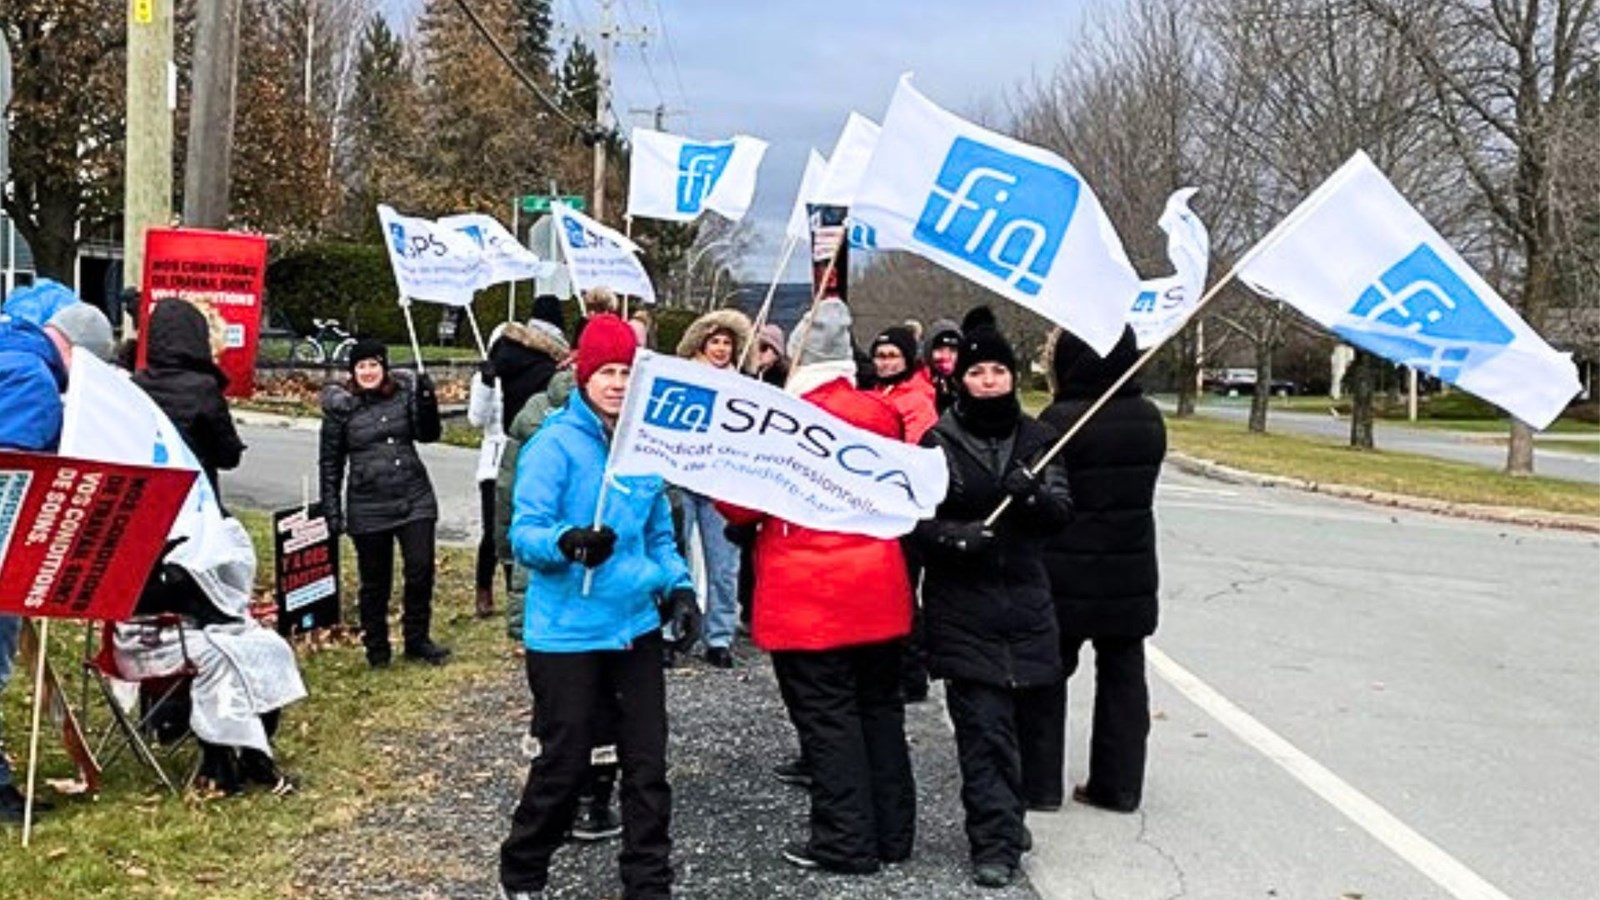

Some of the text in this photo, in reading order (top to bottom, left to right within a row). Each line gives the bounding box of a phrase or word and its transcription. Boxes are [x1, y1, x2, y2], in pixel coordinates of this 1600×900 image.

[932, 166, 1047, 286] fiq
[24, 467, 78, 546] DE SOINS.
[649, 387, 926, 510] fiq SPSCA
[24, 472, 103, 609] VOS CONDITIONS
